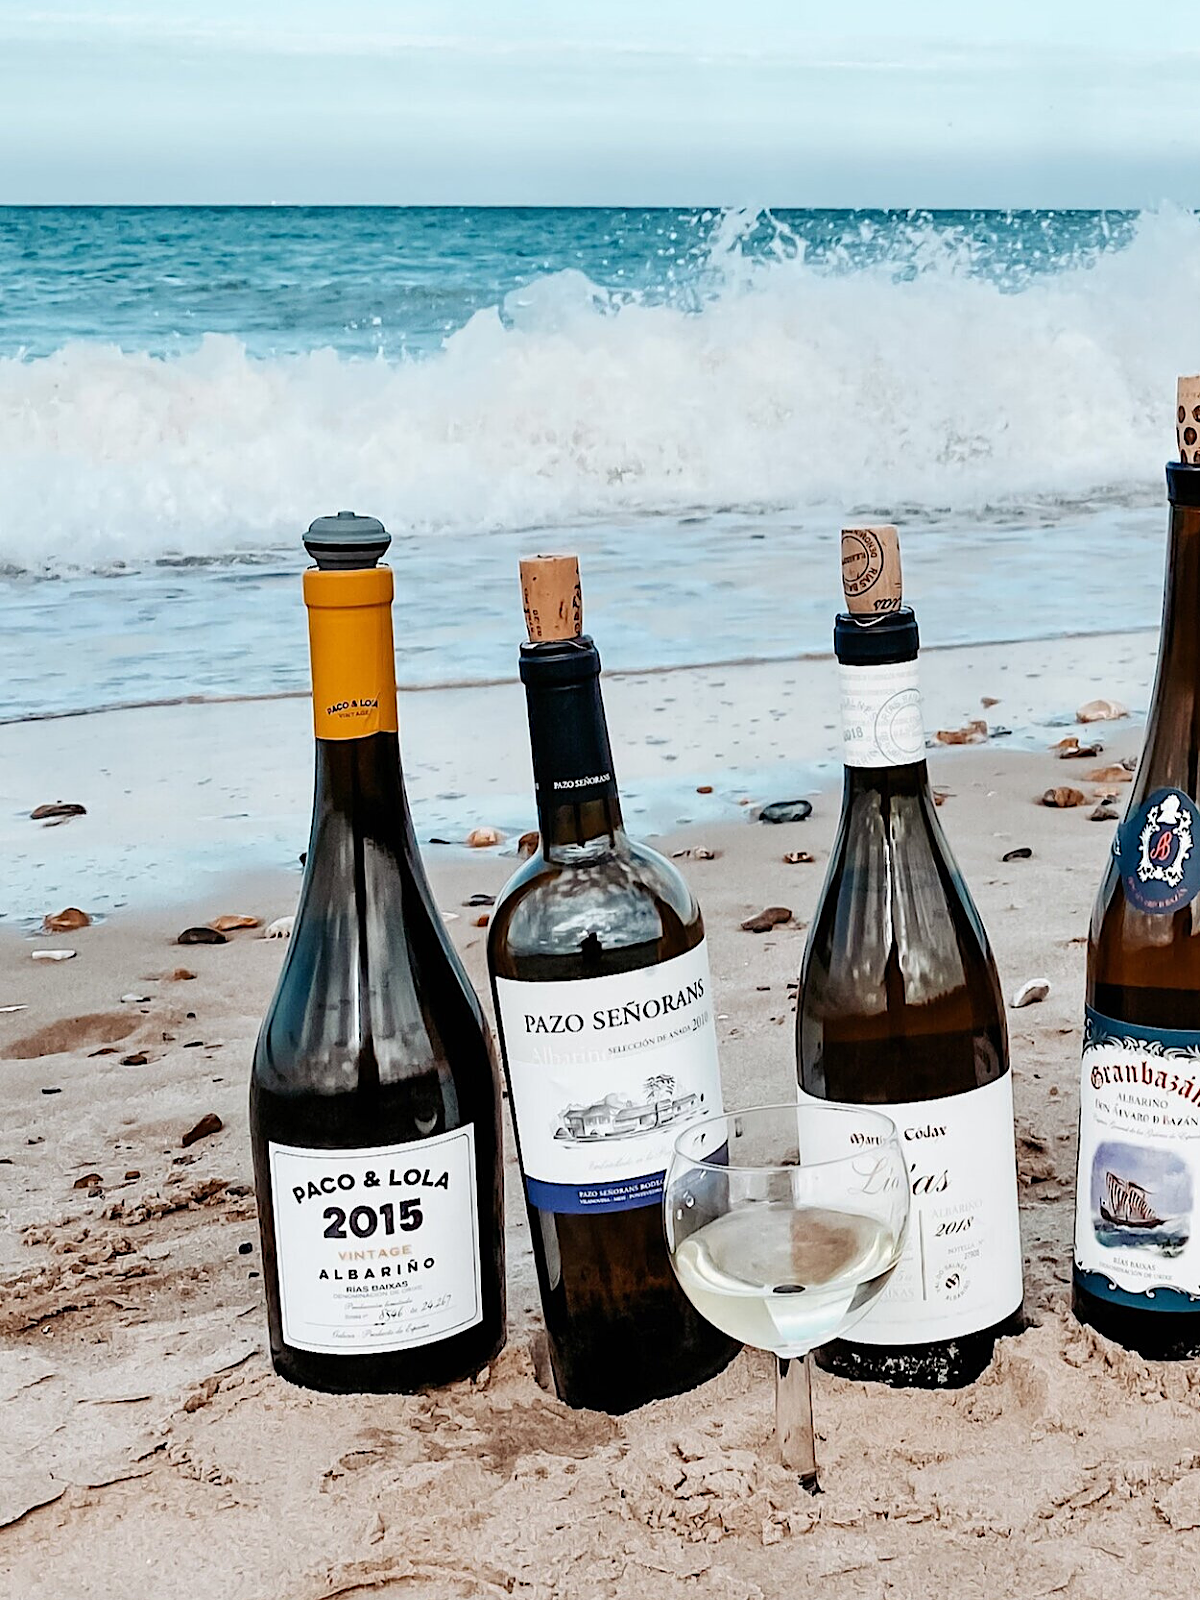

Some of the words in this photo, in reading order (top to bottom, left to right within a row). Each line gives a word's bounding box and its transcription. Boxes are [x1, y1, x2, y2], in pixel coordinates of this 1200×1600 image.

[326, 701, 349, 715] PACO
[351, 700, 358, 708] &
[553, 780, 574, 790] PAZO
[575, 773, 610, 787] SEÑORANS
[524, 1013, 584, 1034] PAZO
[593, 978, 705, 1030] SEÑORANS
[608, 1038, 656, 1054] SELECCIÓN
[656, 1034, 668, 1043] DE
[1118, 1093, 1169, 1109] ALBARIÑO
[1163, 1115, 1199, 1126] BAZÁN
[292, 1173, 355, 1204] PACO
[363, 1171, 380, 1188] &
[389, 1169, 449, 1190] LOLA
[323, 1198, 424, 1239] 2015
[934, 1215, 974, 1237] 2018
[338, 1245, 413, 1261] VINTAGE
[319, 1257, 435, 1280] ALBARIÑO
[346, 1285, 369, 1293] RÍAS
[371, 1281, 408, 1291] BAIXAS
